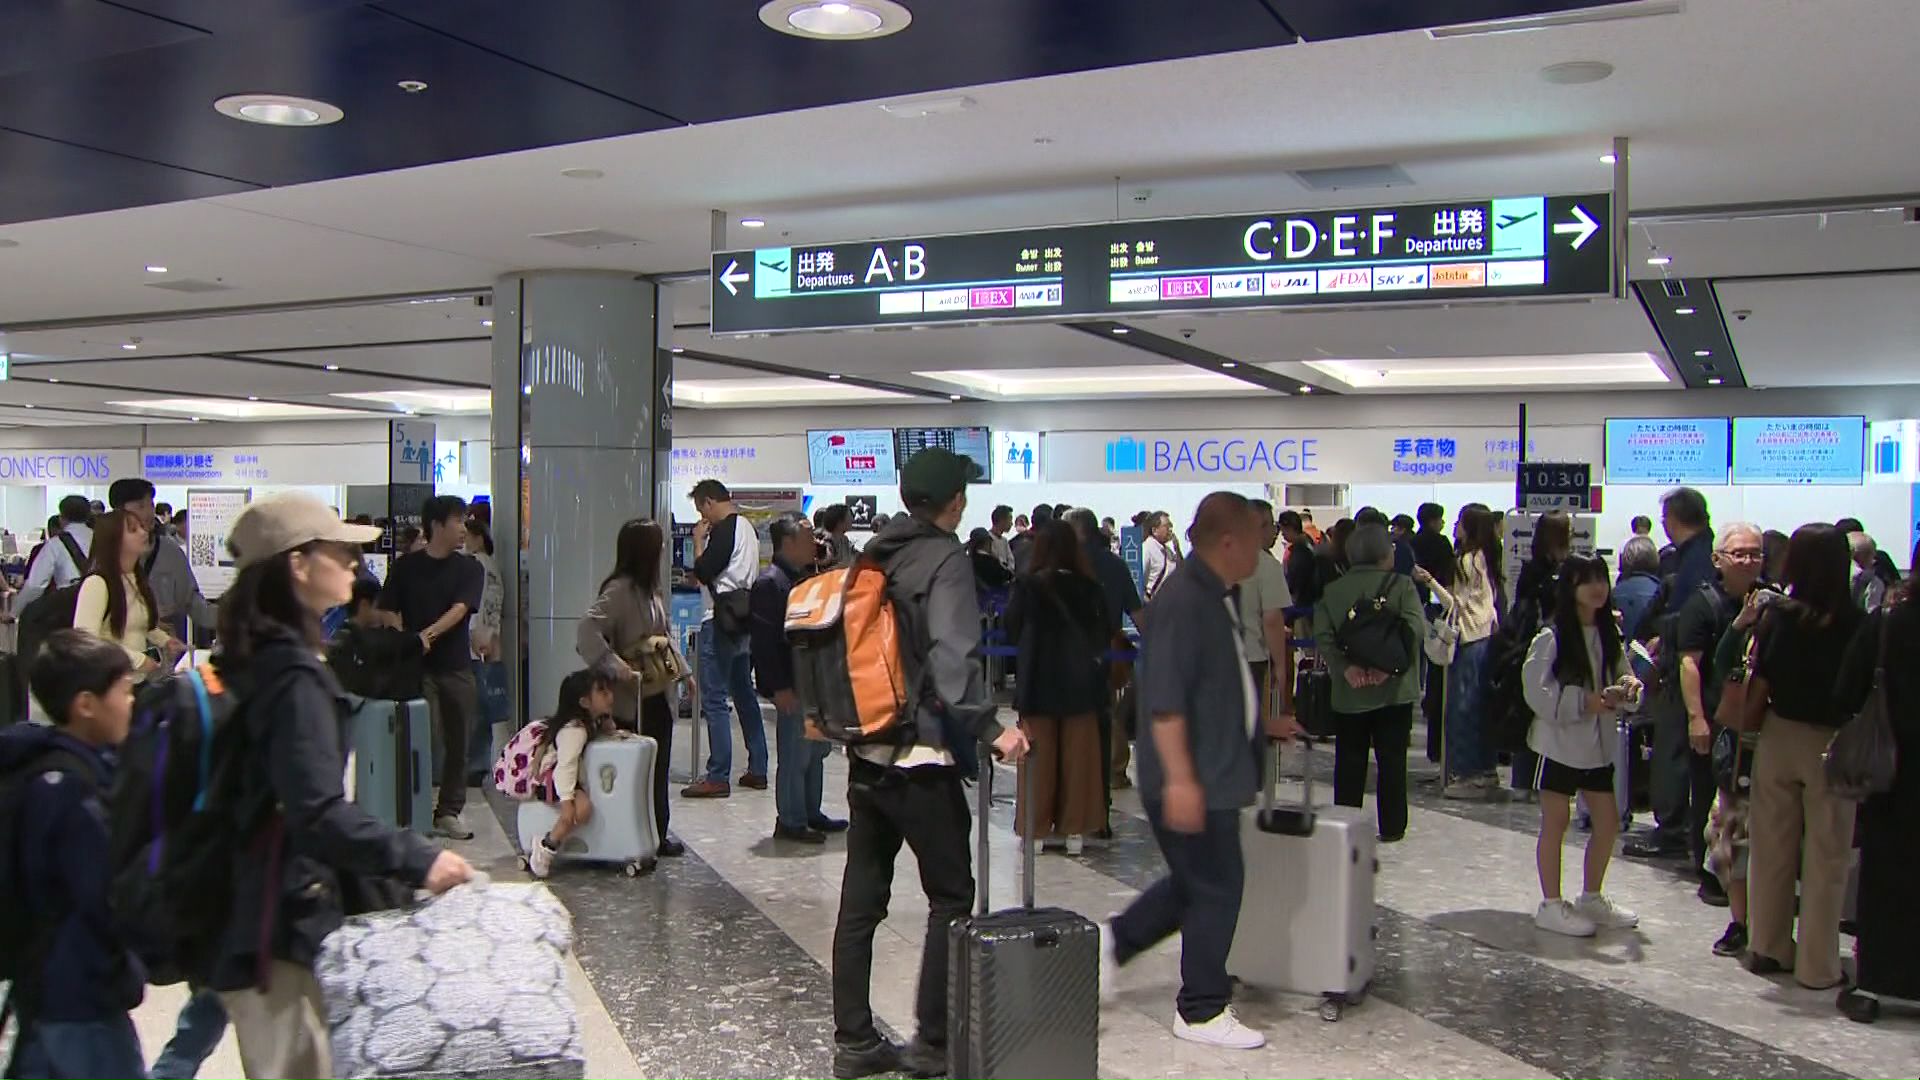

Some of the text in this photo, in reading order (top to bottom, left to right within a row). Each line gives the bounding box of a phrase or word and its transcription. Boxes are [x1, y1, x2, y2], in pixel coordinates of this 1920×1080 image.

[1434, 209, 1483, 235] 出発
[1405, 237, 1484, 256] Departures
[798, 251, 834, 274] 出発
[798, 274, 854, 290] Departures
[1284, 277, 1311, 288] JAL
[1339, 271, 1369, 286] FDA
[1377, 274, 1405, 286] SKY
[1166, 281, 1203, 296] IBEX
[396, 423, 405, 443] 5
[1154, 439, 1319, 473] BAGGAGE
[1393, 438, 1456, 458] 手荷物
[1393, 460, 1453, 475] Baggage
[1125, 535, 1139, 562] 入口
